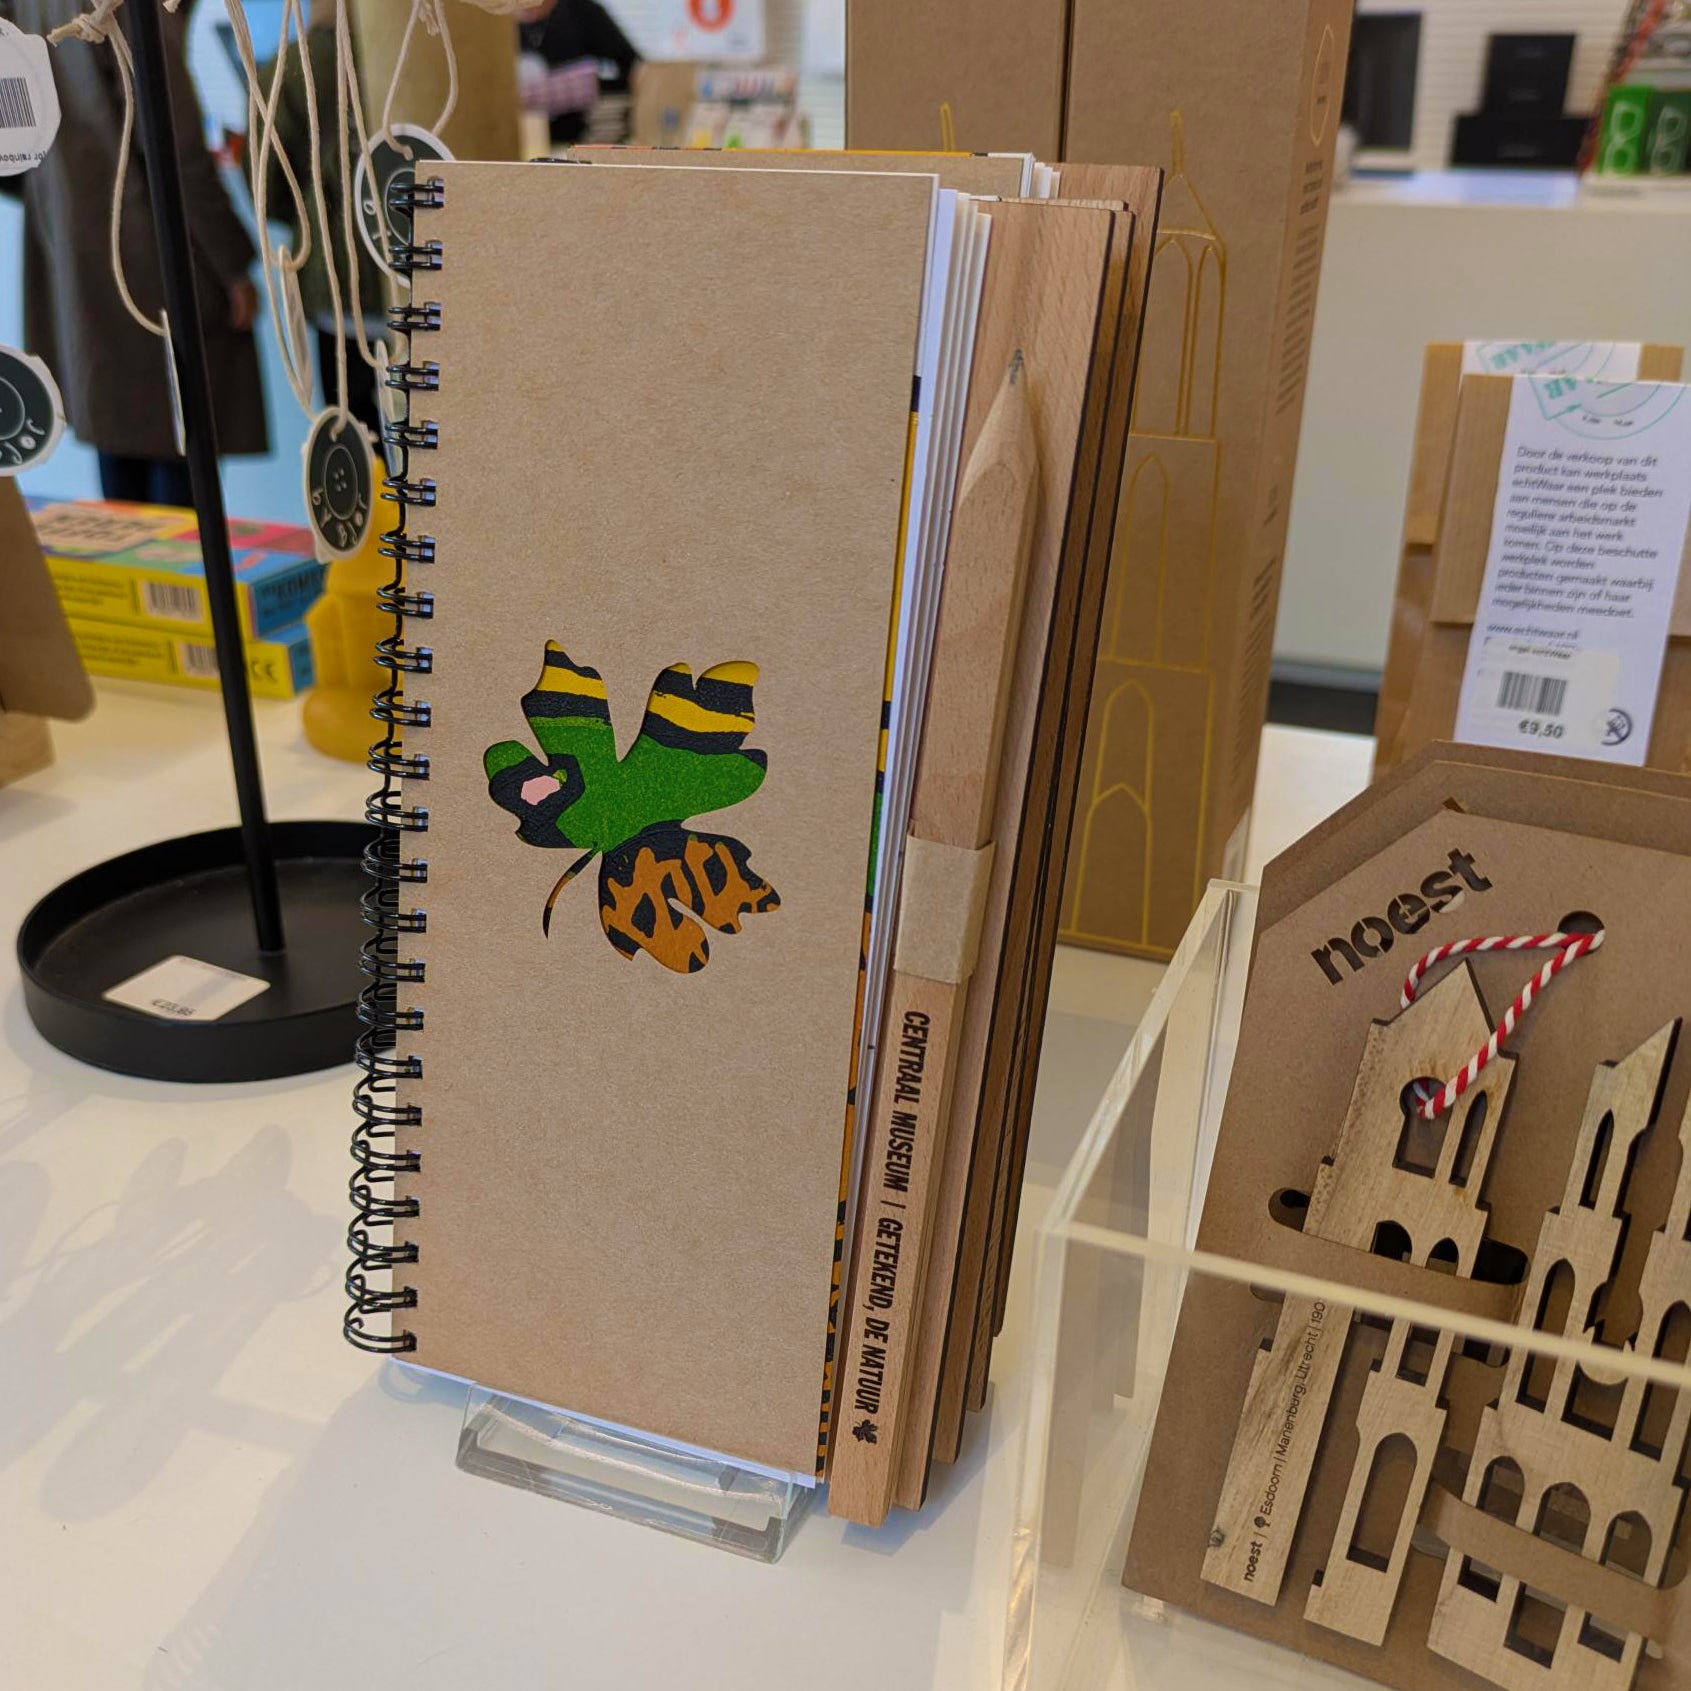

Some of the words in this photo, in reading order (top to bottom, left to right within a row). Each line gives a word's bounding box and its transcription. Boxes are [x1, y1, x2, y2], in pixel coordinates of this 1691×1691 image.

[1517, 446, 1546, 457] Door
[1549, 448, 1563, 460] de
[1567, 450, 1613, 466] verkoop
[1617, 457, 1638, 466] van
[1640, 455, 1659, 467] dit
[1514, 464, 1559, 475] product
[1561, 465, 1581, 477] kan
[1584, 468, 1647, 482] werkplaats
[1567, 483, 1589, 493] een
[1591, 481, 1616, 496] plek
[1620, 485, 1663, 498] bieden
[1509, 494, 1529, 503] aan
[1531, 496, 1576, 507] mensen
[1578, 497, 1598, 509] die
[1600, 502, 1617, 512] op
[1620, 499, 1637, 512] de
[1506, 508, 1555, 521] reguliere
[1558, 512, 1637, 528] arbeidsmarkt
[1504, 523, 1547, 537] moeilijk
[1549, 528, 1570, 538] aan
[1572, 527, 1593, 539] het
[1595, 530, 1624, 542] werk
[1544, 540, 1563, 553] Op
[1566, 542, 1596, 555] deze
[1597, 546, 1658, 559] beschutte
[1501, 552, 1548, 565] werkplek
[1550, 557, 1595, 569] worden
[1498, 568, 1553, 582] producten
[1556, 574, 1608, 586] gemaakt
[1610, 577, 1654, 592] waarbij
[1524, 584, 1564, 596] binnen
[1588, 589, 1604, 600] of
[1605, 592, 1631, 603] haar
[1492, 598, 1574, 613] mogelijkheden
[1518, 719, 1564, 739] €9,50
[1311, 848, 1493, 986] noest
[894, 1011, 930, 1104] CENTRAAL
[883, 1110, 917, 1192] MUSEUM
[863, 1217, 903, 1311] GETEKEND,
[864, 1317, 890, 1343] DE
[854, 1344, 886, 1414] NATUUR
[1244, 1540, 1264, 1582] noest
[1260, 1463, 1283, 1516] Esdoorn
[1301, 1331, 1319, 1380] Utrecht
